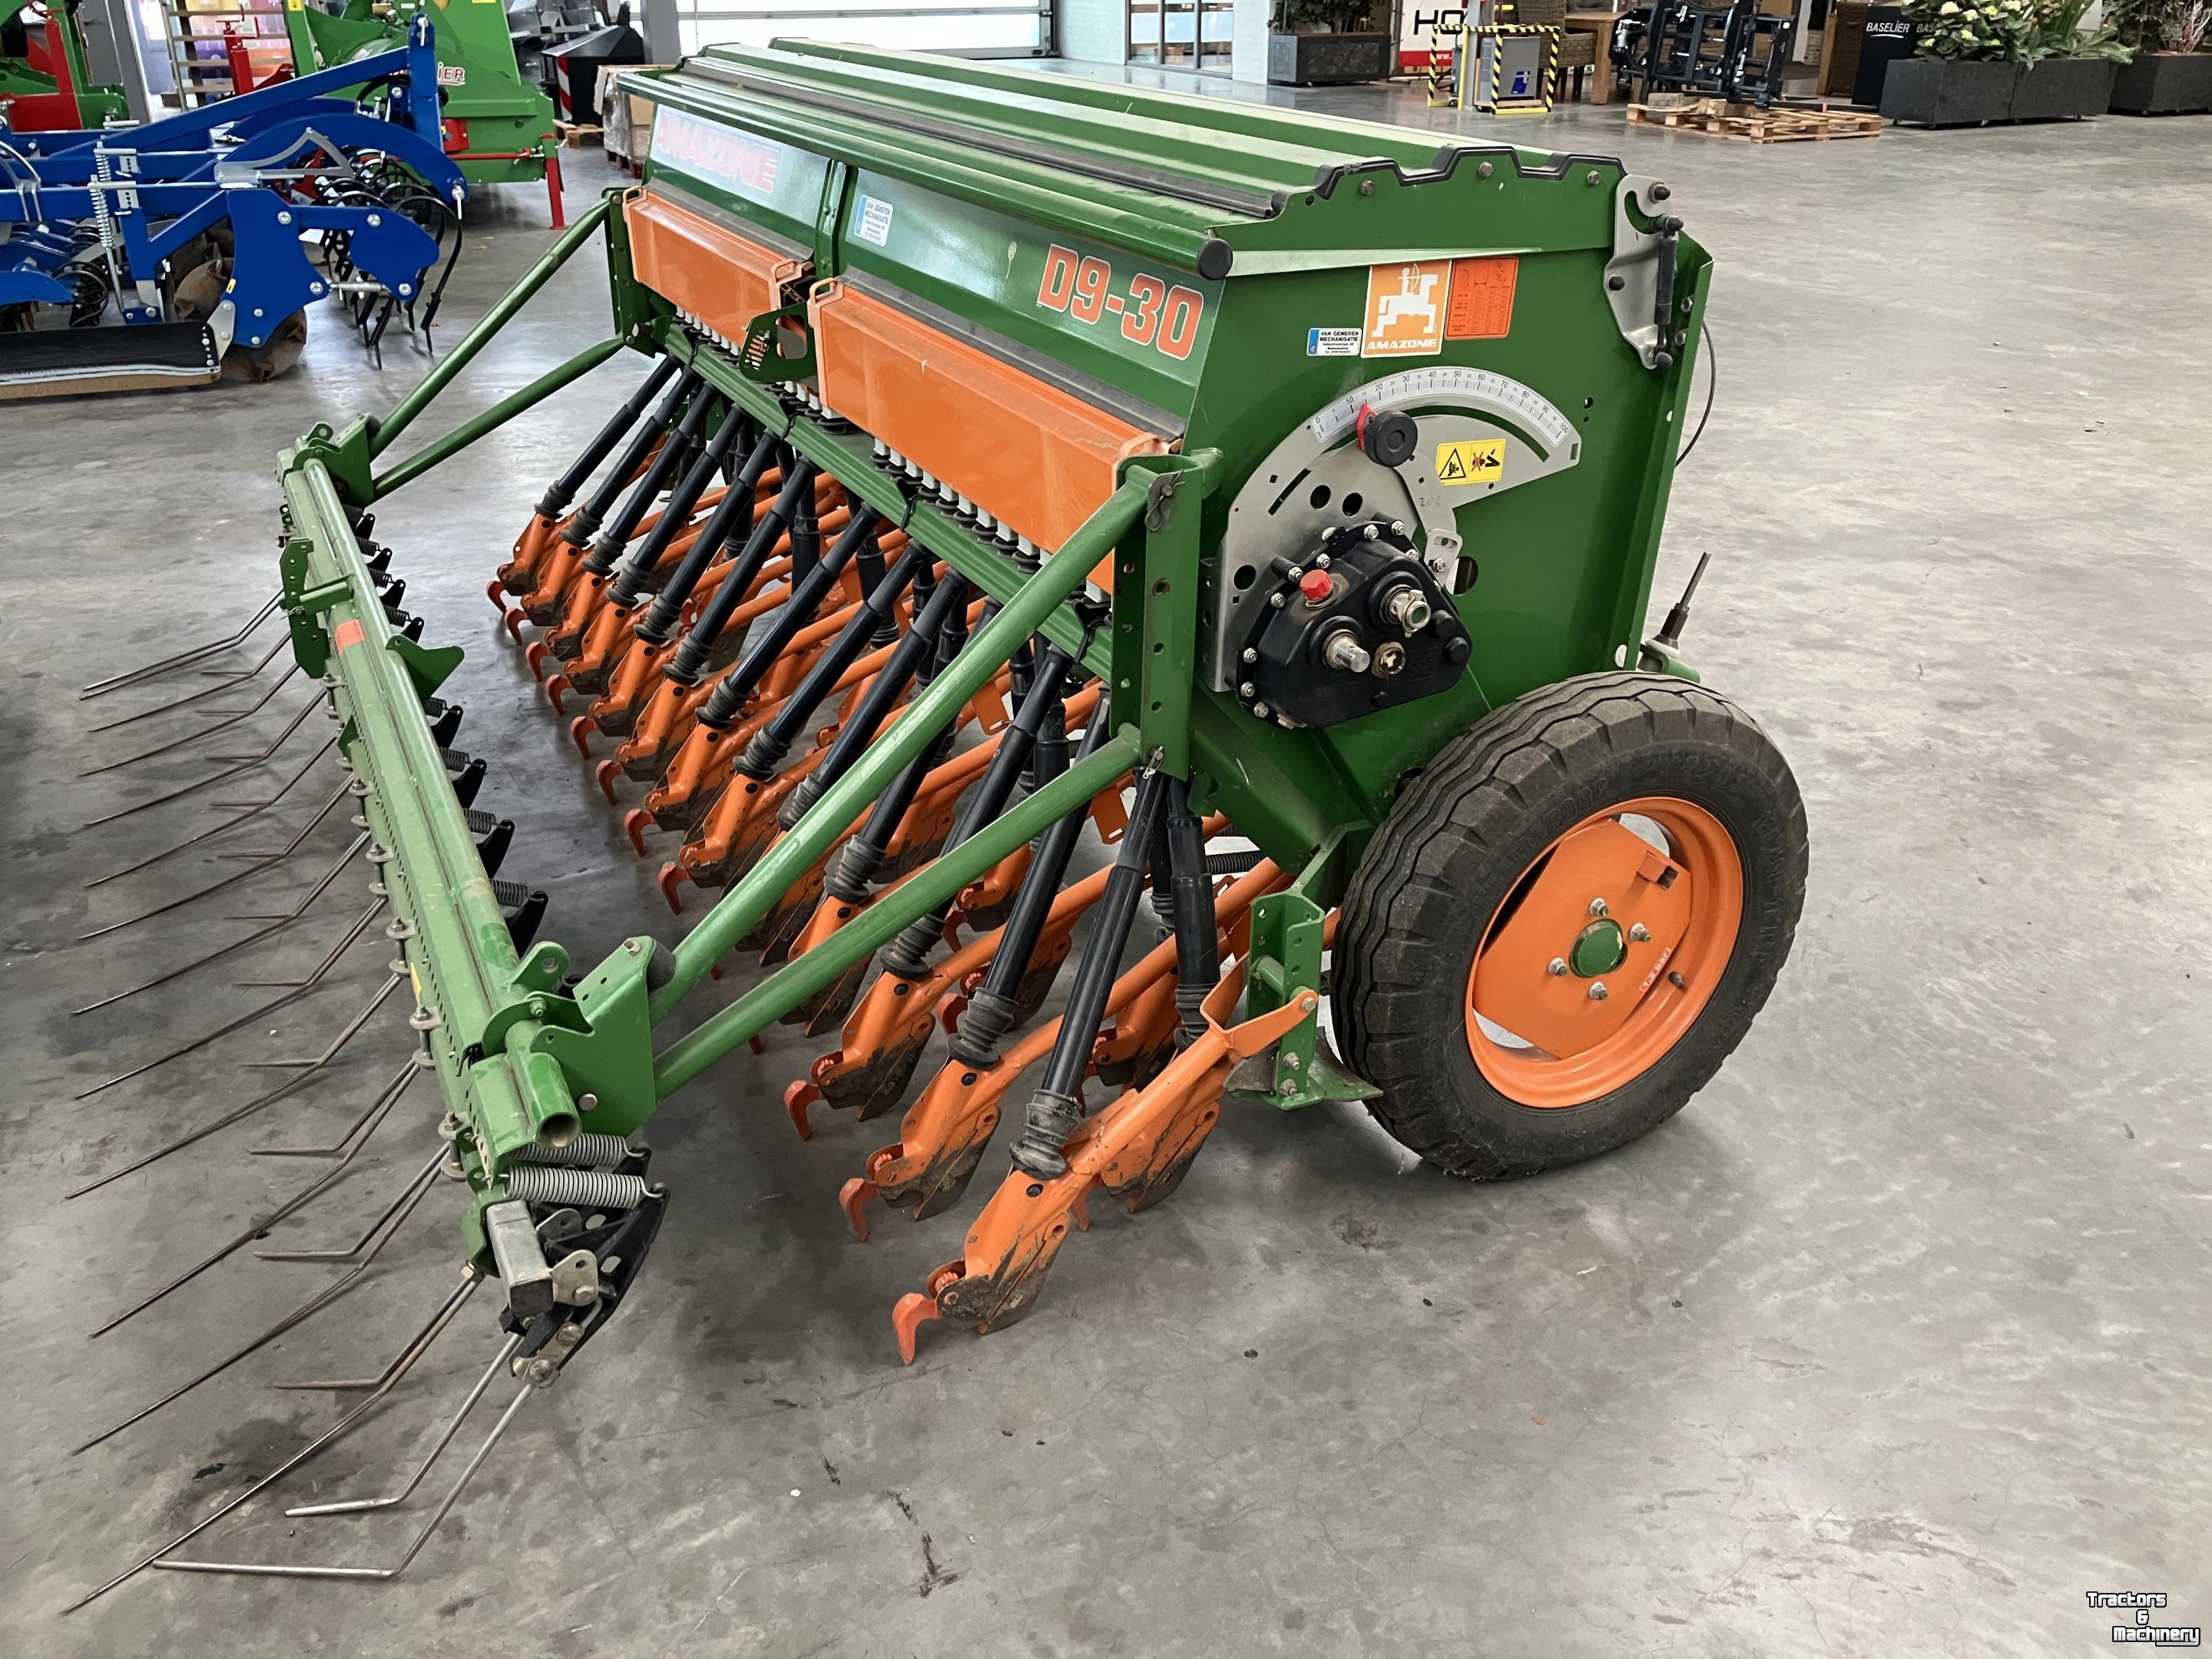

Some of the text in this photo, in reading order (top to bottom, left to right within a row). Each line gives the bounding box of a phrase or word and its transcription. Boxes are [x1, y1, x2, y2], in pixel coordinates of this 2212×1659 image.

[1916, 23, 1934, 33] BAS
[656, 112, 780, 194] AMAZONE
[1037, 243, 1204, 360] D9-30
[1366, 339, 1437, 350] AMAZONE
[1375, 383, 1383, 392] 20
[1500, 380, 1508, 389] 70
[1522, 390, 1530, 399] 80
[1541, 405, 1550, 413] 90
[1560, 422, 1569, 433] 100
[1654, 952, 1667, 971] bar
